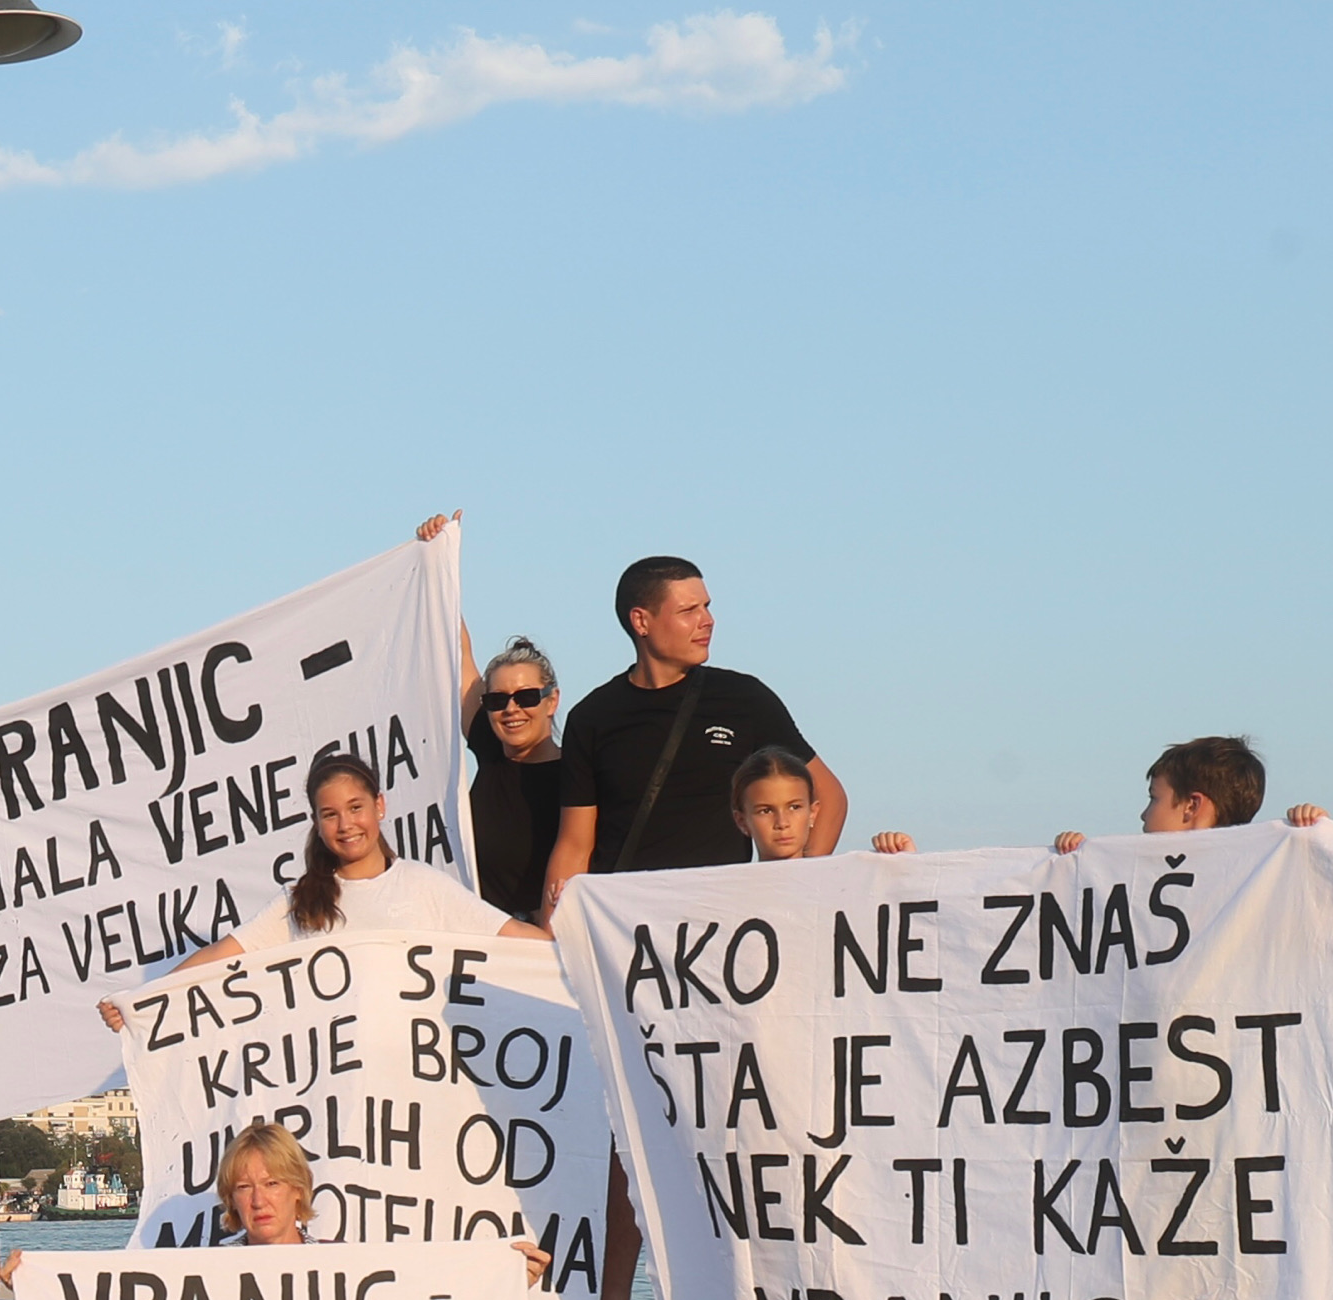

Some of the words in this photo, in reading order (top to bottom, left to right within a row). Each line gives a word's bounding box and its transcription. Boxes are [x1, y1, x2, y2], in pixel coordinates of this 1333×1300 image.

[149, 714, 419, 863] VENEJA
[62, 878, 240, 982] VELIKA
[626, 918, 778, 1012] AKO
[833, 901, 942, 997] NE
[981, 854, 1193, 984] ZNAŠ
[133, 947, 350, 1051] ZAŠTO
[400, 947, 487, 1006] SE
[199, 1016, 363, 1107] KRIJE
[412, 1019, 571, 1112] BROJ
[641, 1024, 776, 1130] ŠTA
[807, 1035, 895, 1148] JE
[938, 1013, 1301, 1128] AZBEST
[183, 1097, 420, 1194] URLIH
[457, 1114, 554, 1188] OD
[697, 1153, 866, 1246] NEK
[893, 1158, 964, 1246] TI
[1034, 1137, 1286, 1256] KAŽE
